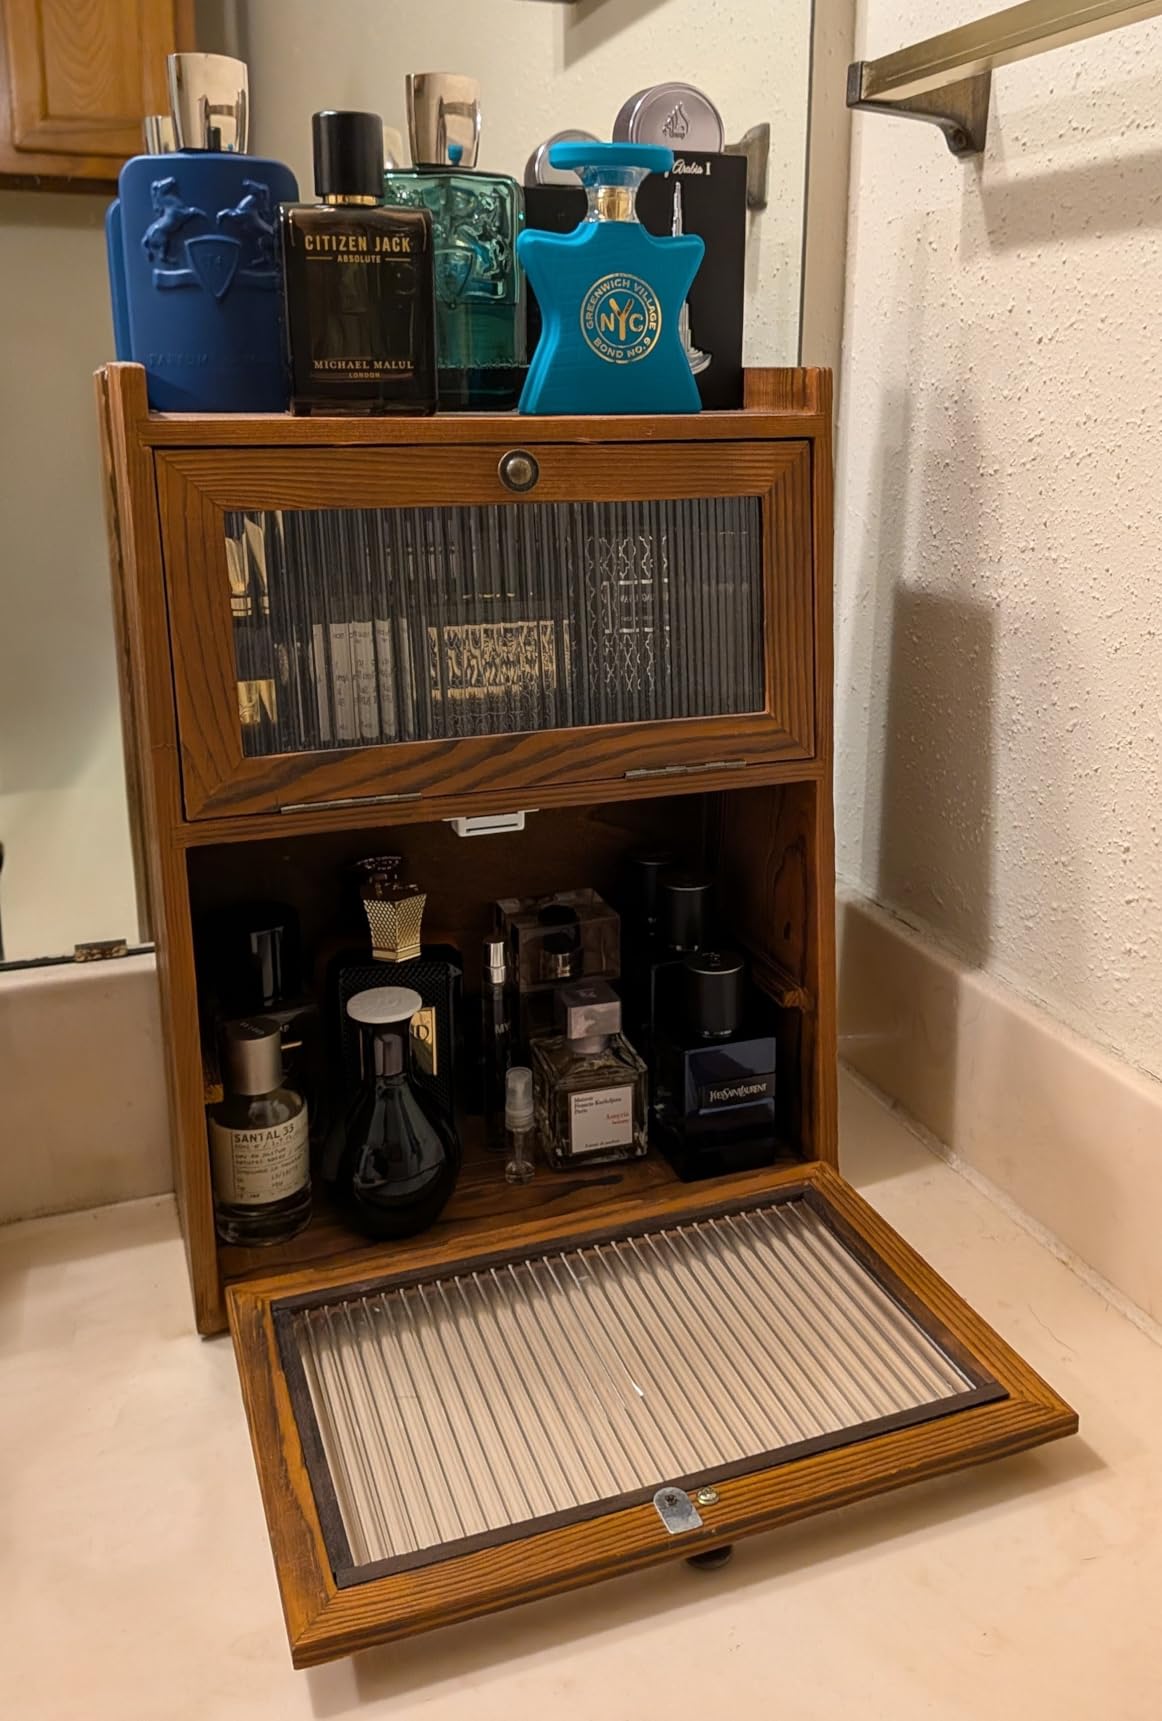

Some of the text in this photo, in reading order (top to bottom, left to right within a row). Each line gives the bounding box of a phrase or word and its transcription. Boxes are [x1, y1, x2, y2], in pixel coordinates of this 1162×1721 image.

[304, 234, 411, 252] CITIZEN JACK
[336, 254, 382, 264] ABSOLUTE
[585, 277, 657, 331] GREENWICH VILLAGE
[600, 297, 644, 341] NYC
[592, 337, 623, 359] BOND
[313, 359, 415, 369] MICHAEL MALUL
[348, 371, 382, 379] LONDON
[234, 1130, 281, 1144] SANTAL
[282, 1122, 295, 1136] 33
